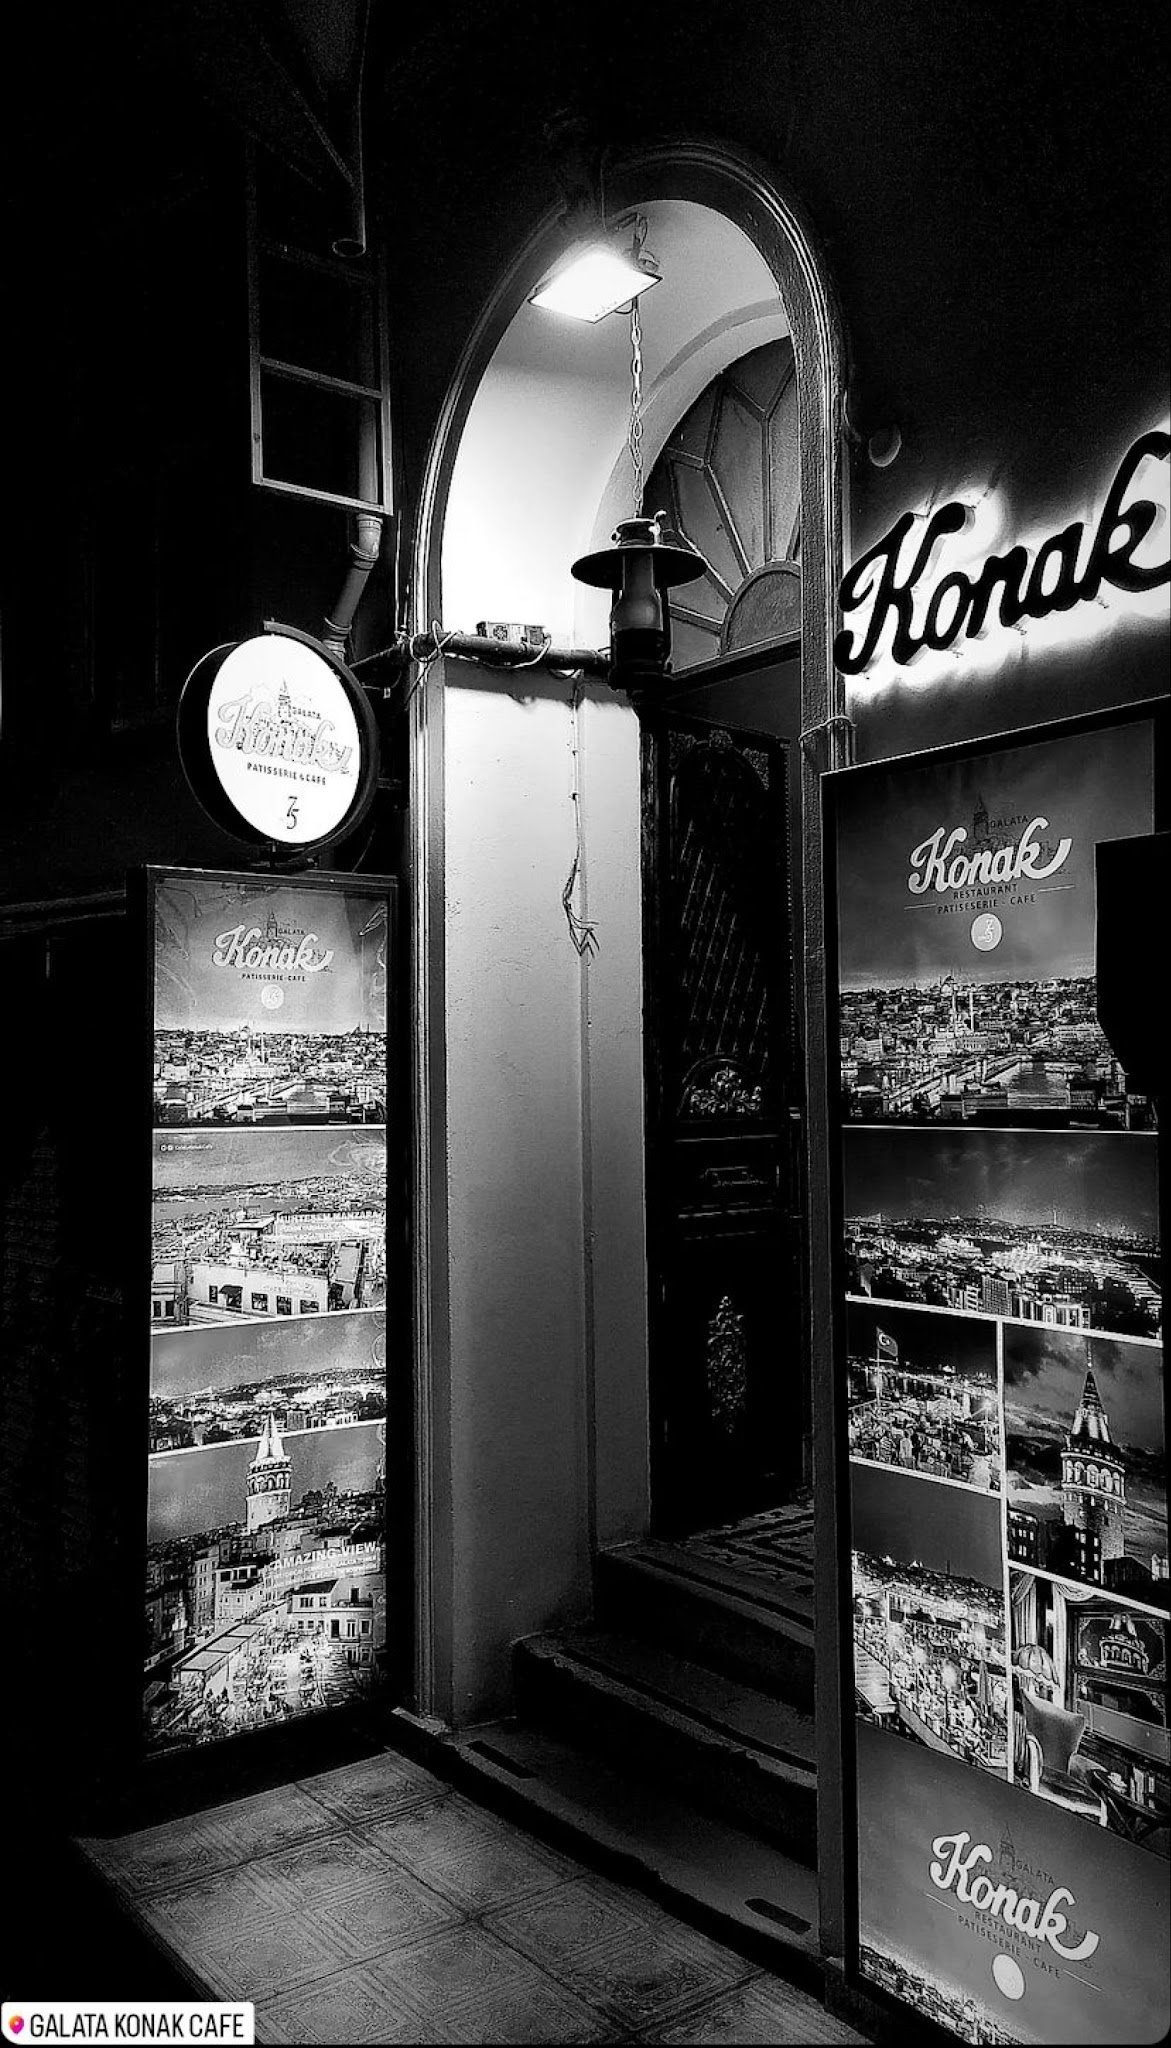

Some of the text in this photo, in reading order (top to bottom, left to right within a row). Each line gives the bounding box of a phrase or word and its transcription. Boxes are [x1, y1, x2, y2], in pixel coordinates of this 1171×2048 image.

[834, 431, 1171, 675] Konak
[215, 694, 353, 772] Konak
[991, 815, 1029, 828] GALATA
[908, 816, 1073, 894] Konak
[937, 899, 999, 915] PATISESERIE
[1010, 894, 1036, 906] CAFE
[953, 884, 1018, 900] RESTAURANT
[213, 925, 334, 971] Konak
[274, 1548, 337, 1569] AMAZING
[1016, 1860, 1056, 1884] GALATA
[929, 1831, 1100, 1961] Konak
[957, 1915, 1020, 1956] PATISESERIE
[1033, 1957, 1061, 1979] CAFE
[974, 1911, 1041, 1953] RESTAURANT
